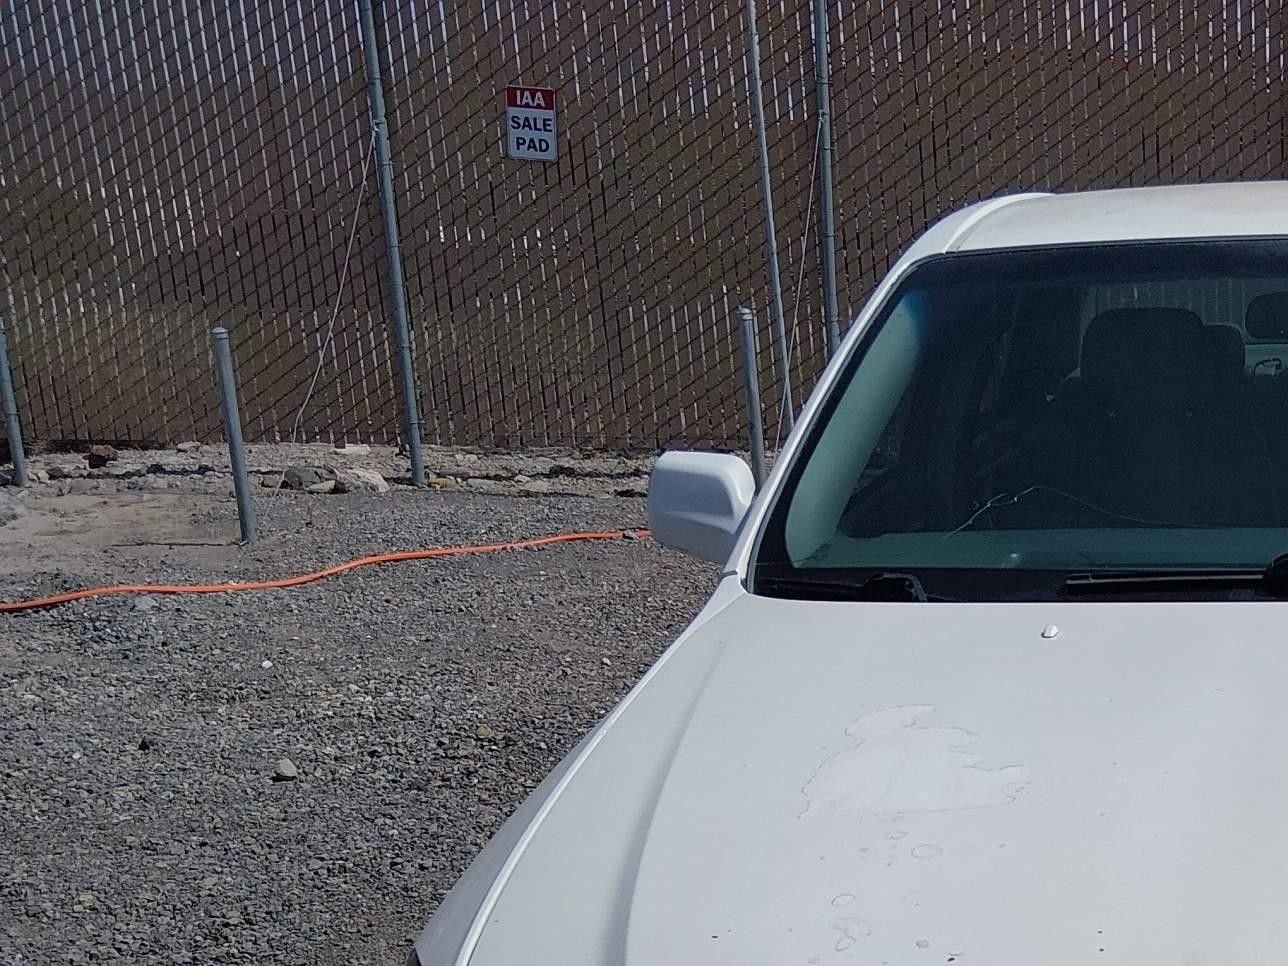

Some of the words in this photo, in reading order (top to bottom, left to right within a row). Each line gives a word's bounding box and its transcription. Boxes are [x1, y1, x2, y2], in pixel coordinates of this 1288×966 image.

[516, 90, 545, 107] IAA
[510, 115, 552, 132] SALE
[516, 136, 549, 153] PAD
